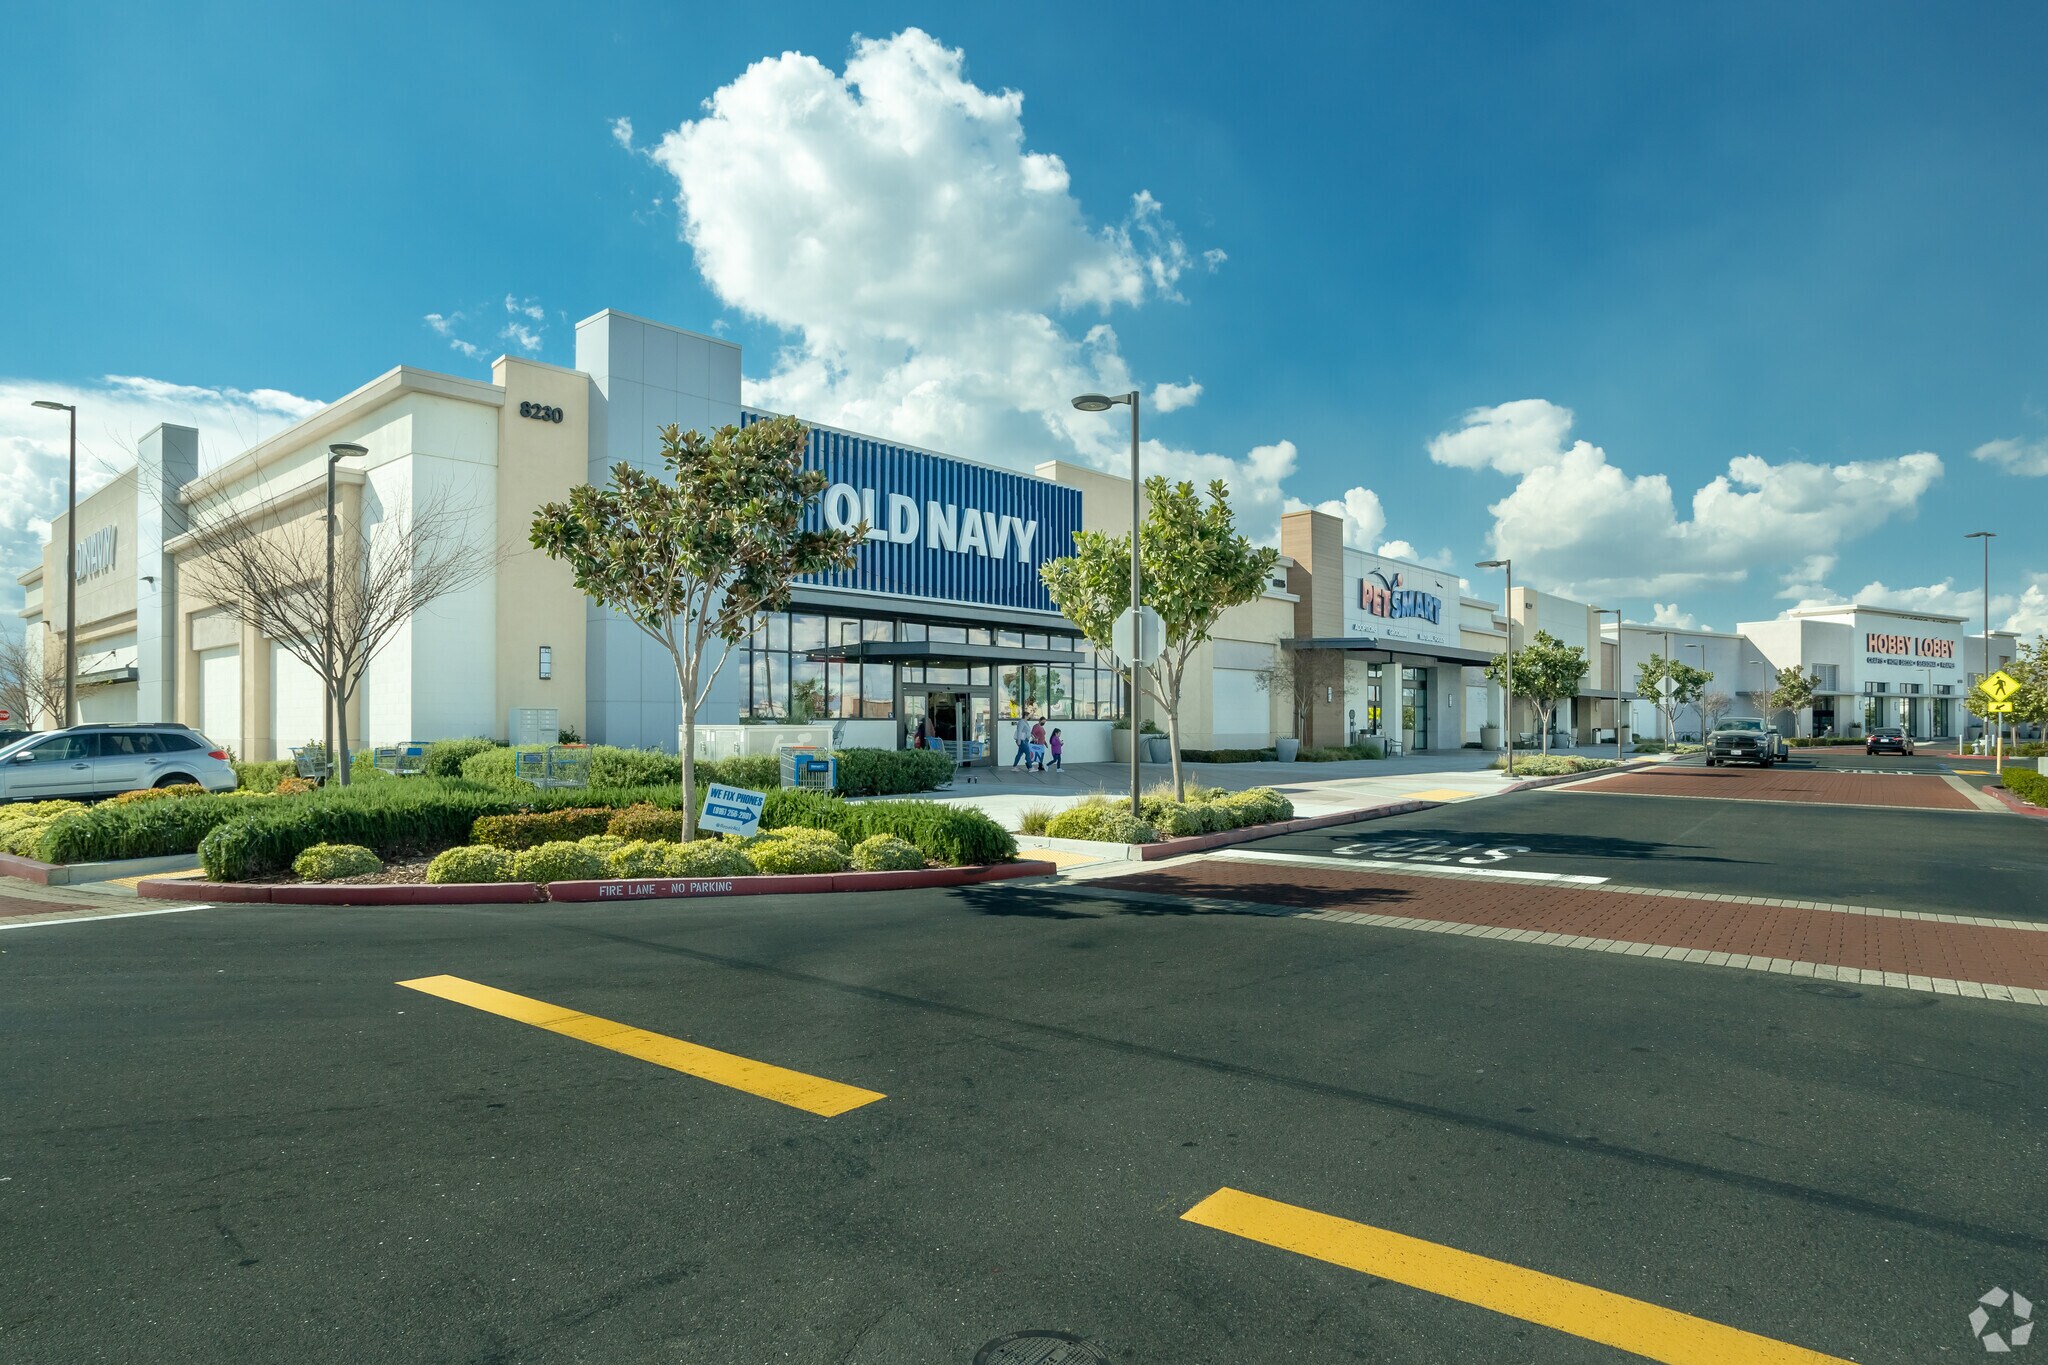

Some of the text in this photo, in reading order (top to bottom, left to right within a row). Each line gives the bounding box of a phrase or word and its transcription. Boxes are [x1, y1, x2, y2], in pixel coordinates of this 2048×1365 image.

[520, 401, 563, 423] 8230
[824, 483, 1038, 563] OLD NAVY
[84, 525, 115, 575] NAVY
[1867, 633, 1955, 658] HOBBY LOBBY
[710, 788, 763, 806] WE FIX PHONES
[599, 885, 623, 896] FIRE
[628, 884, 656, 895] LANE
[671, 883, 685, 893] NO
[690, 881, 732, 892] PARKING
